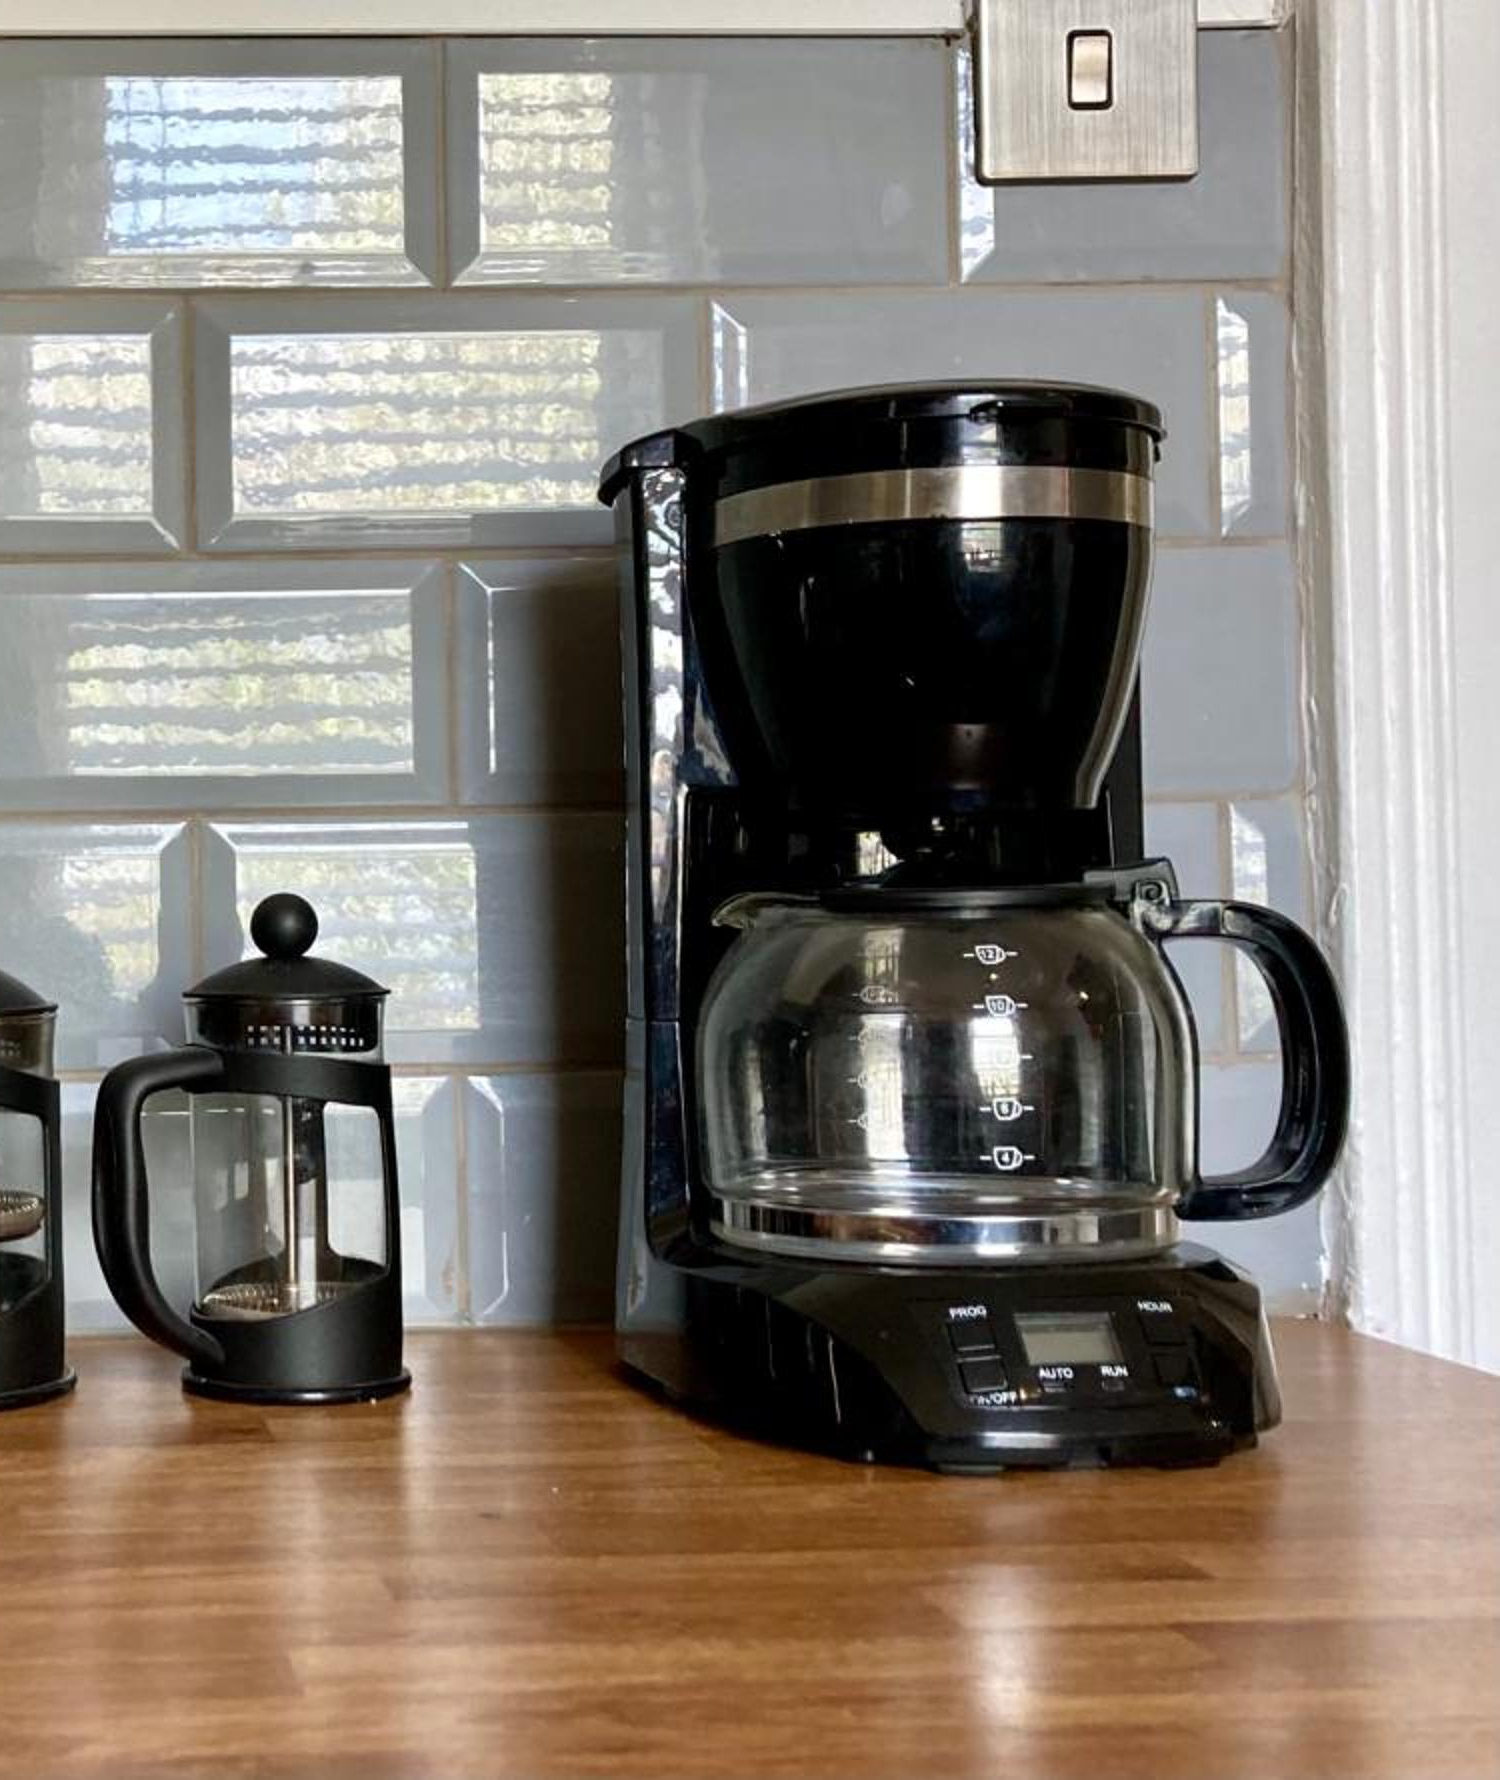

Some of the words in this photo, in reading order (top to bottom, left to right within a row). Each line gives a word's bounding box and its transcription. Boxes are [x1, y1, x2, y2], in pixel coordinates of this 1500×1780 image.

[980, 948, 995, 960] 12
[948, 1304, 987, 1319] PROG
[1137, 1300, 1173, 1313] HOUR
[1038, 1366, 1074, 1379] AUTO
[1100, 1365, 1129, 1377] RUN
